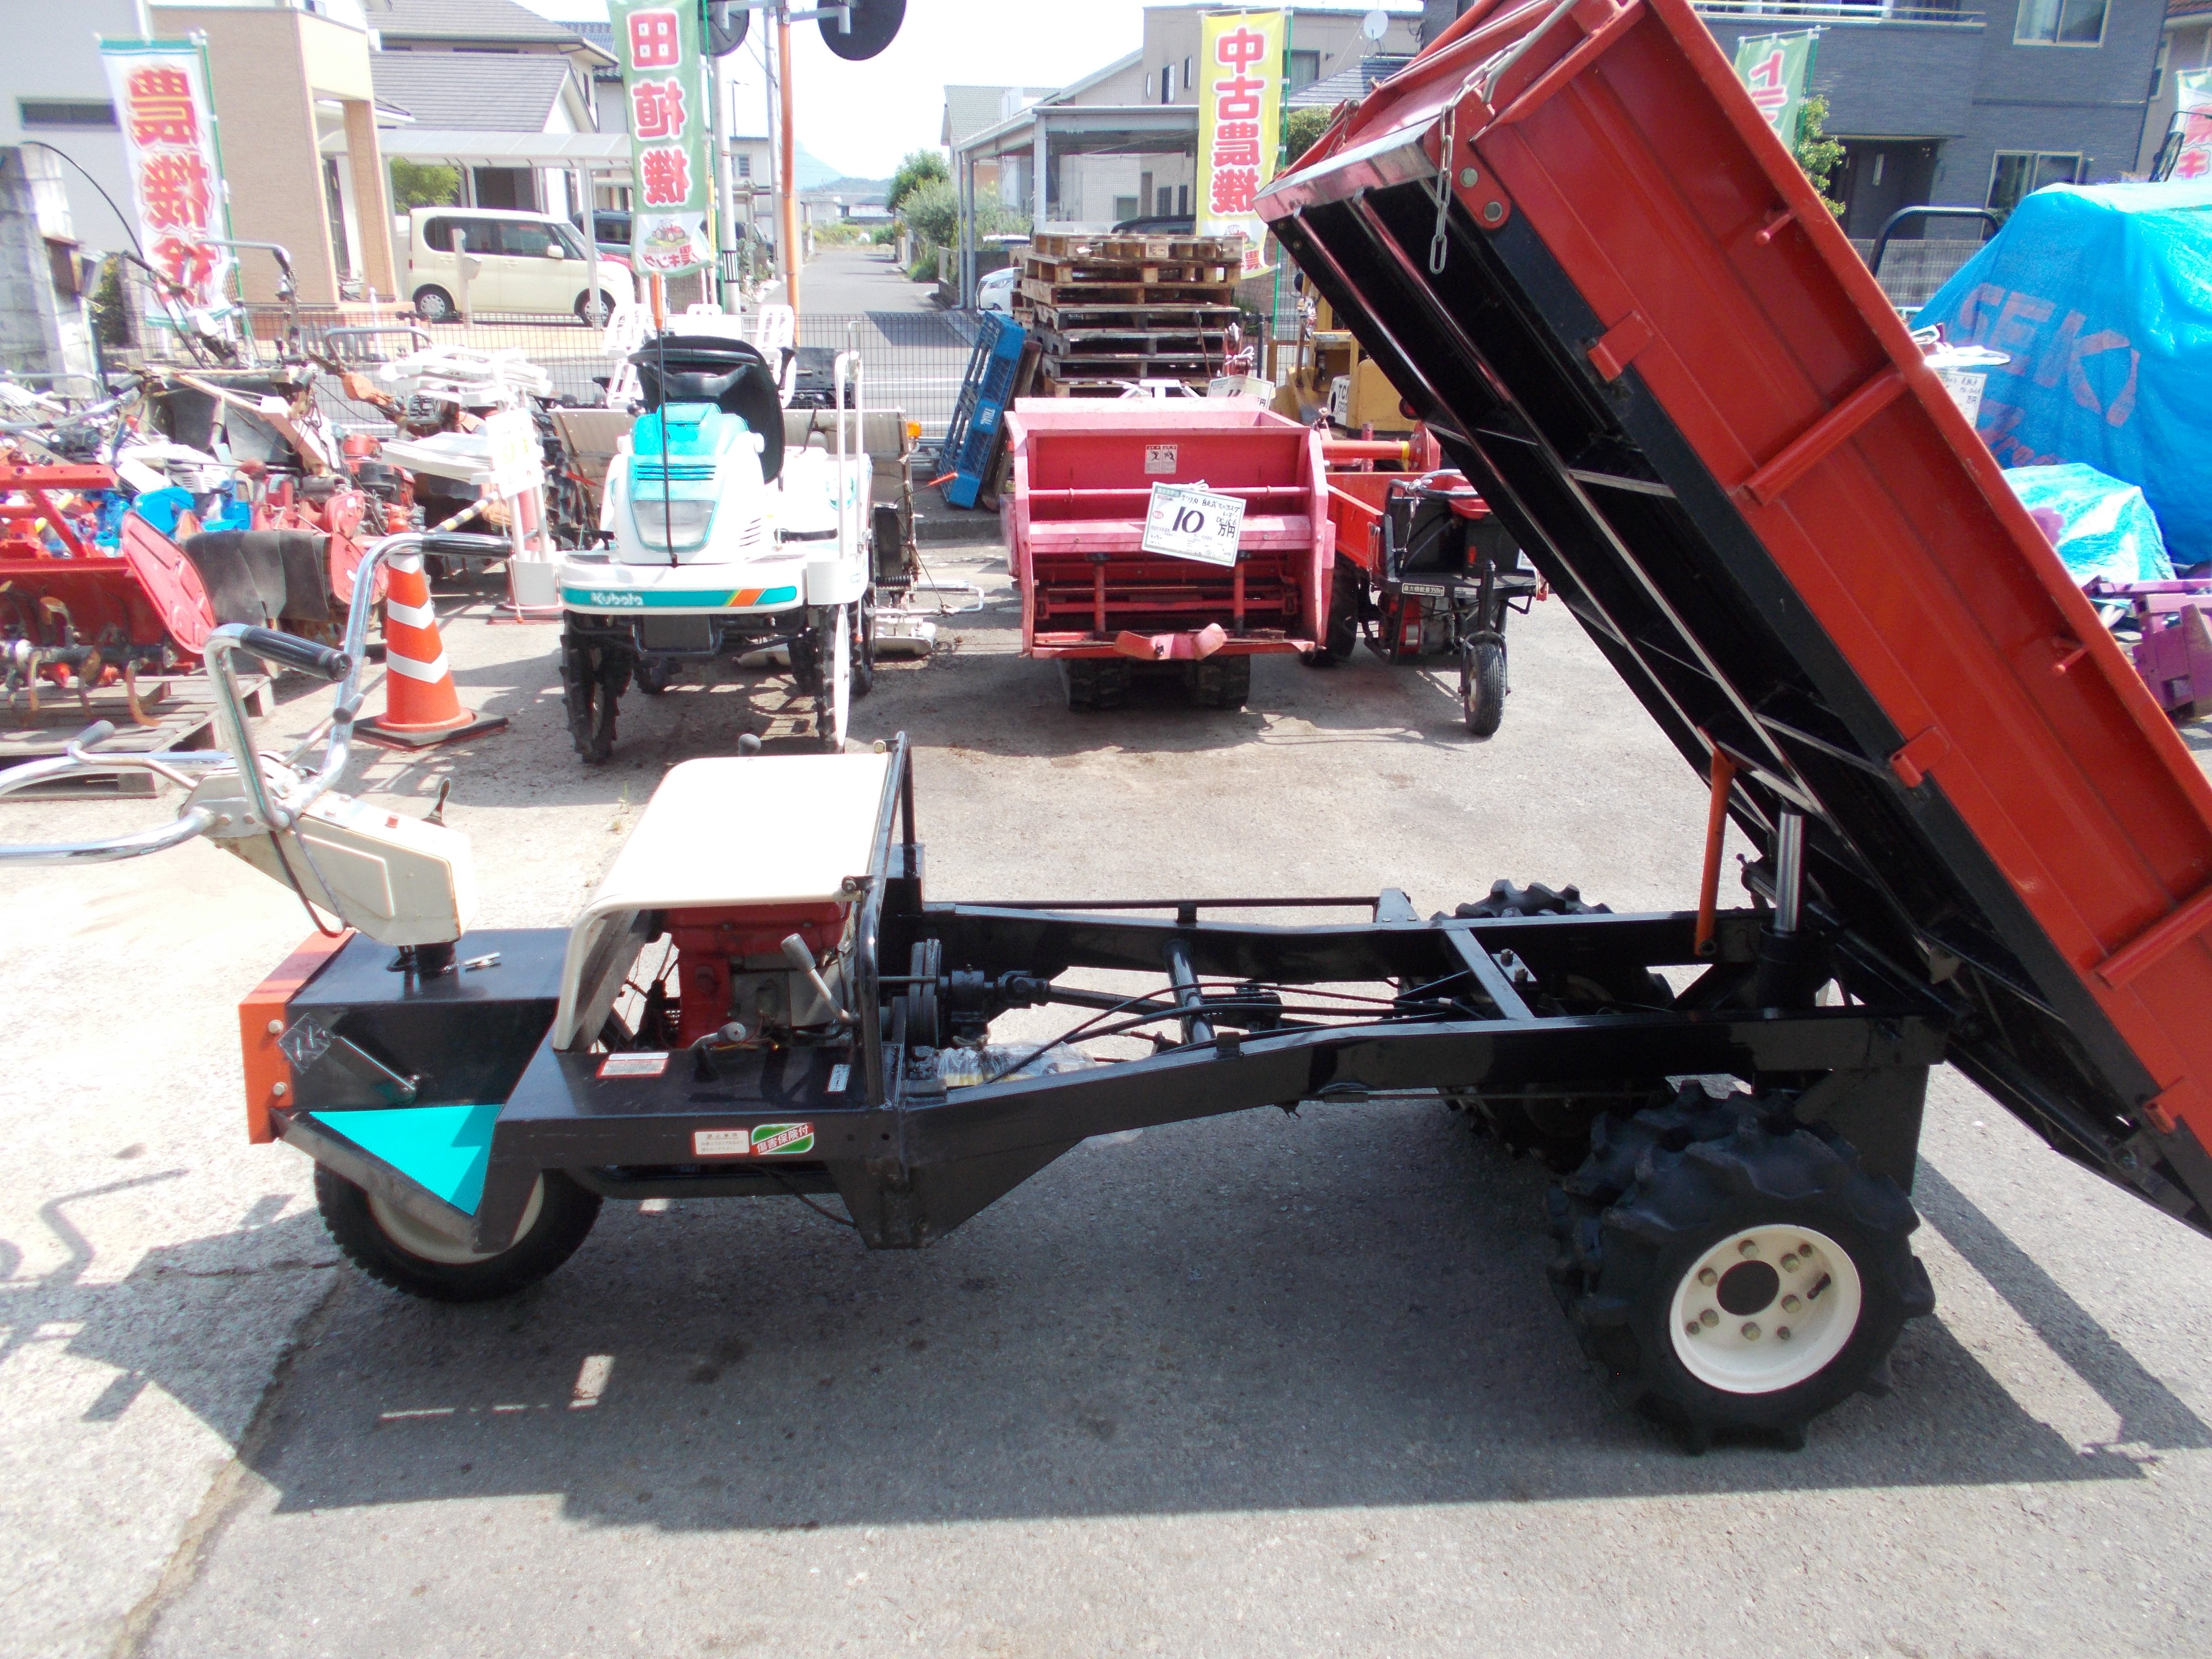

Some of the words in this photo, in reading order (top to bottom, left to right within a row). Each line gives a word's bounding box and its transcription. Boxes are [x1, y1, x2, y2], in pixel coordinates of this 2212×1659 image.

[981, 407, 996, 425] TRIAL
[1172, 506, 1204, 533] 10
[1217, 524, 1236, 539] 万円
[590, 592, 644, 605] Kubota
[757, 1124, 809, 1154] 傷害保険付
